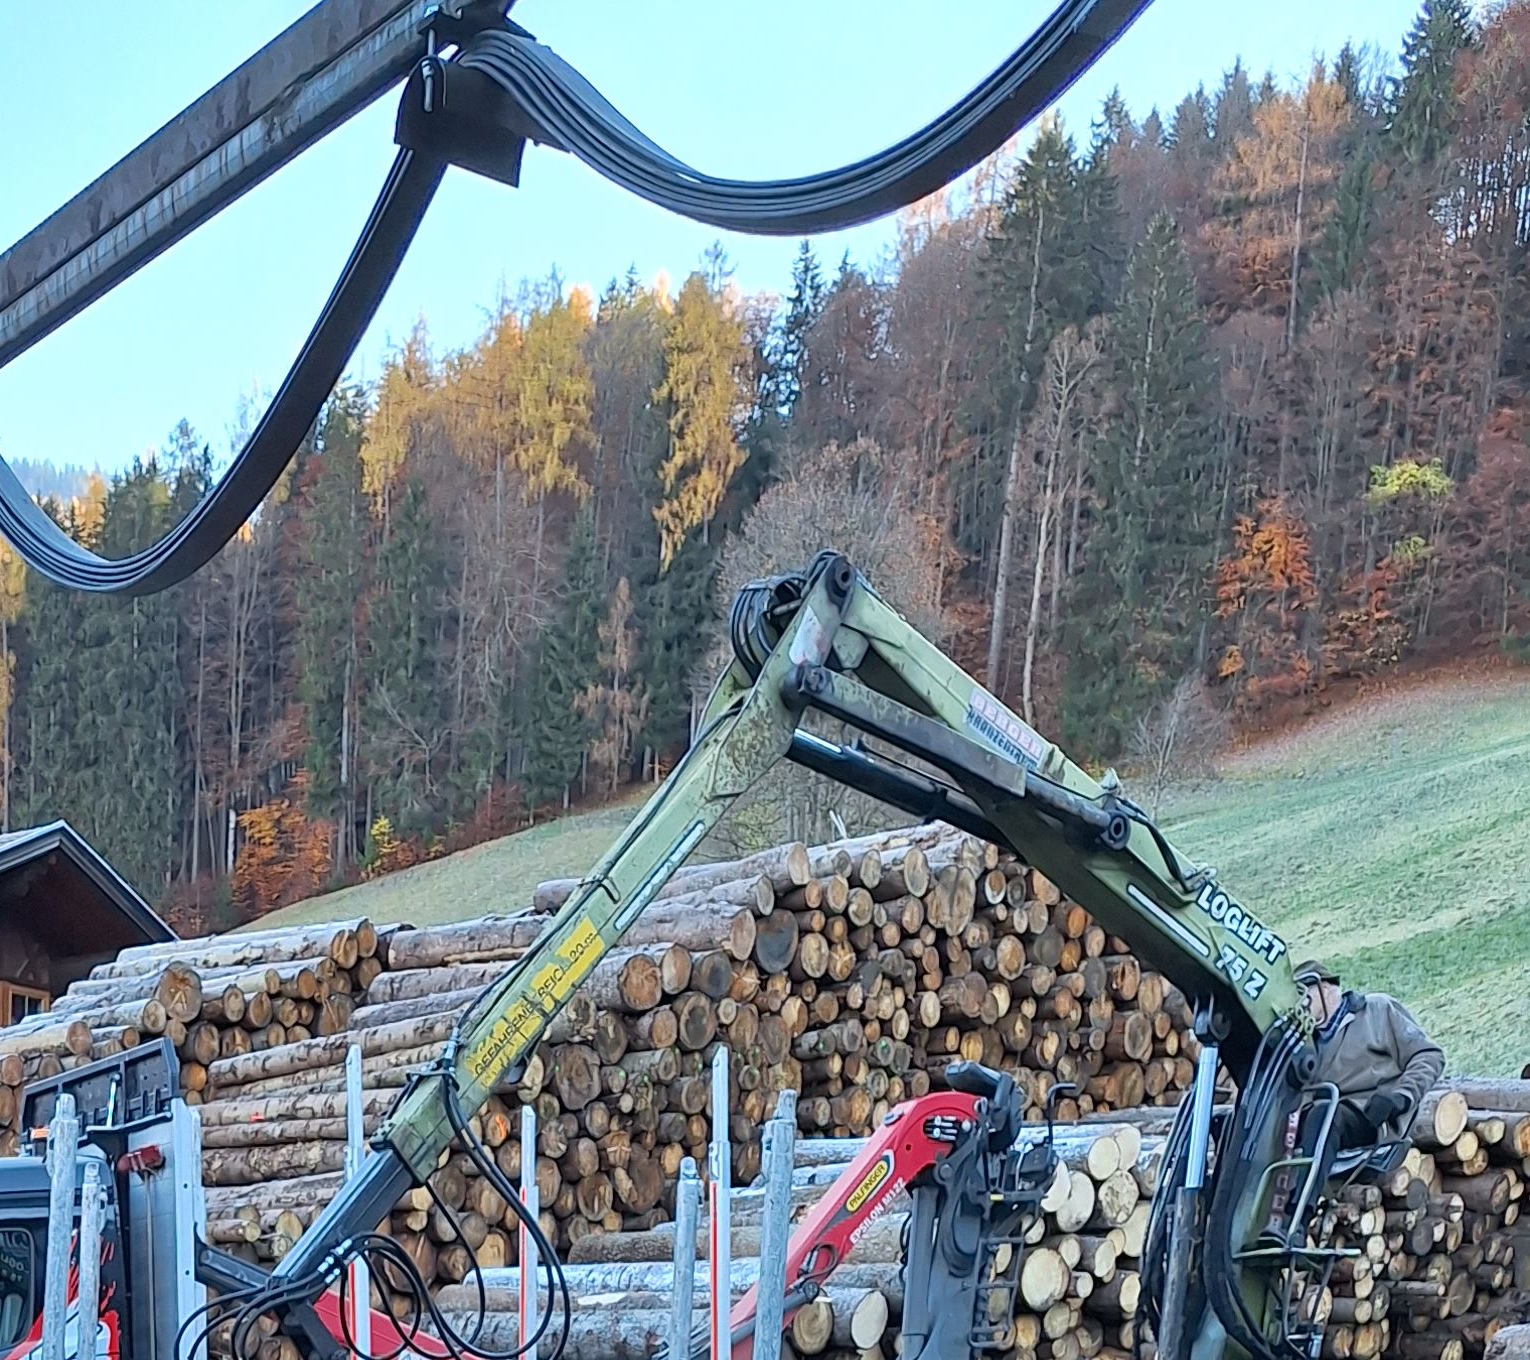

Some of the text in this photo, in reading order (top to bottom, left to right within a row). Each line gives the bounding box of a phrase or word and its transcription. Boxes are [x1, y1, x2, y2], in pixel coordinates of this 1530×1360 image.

[1197, 883, 1286, 965] LOGLIFT
[1214, 943, 1268, 1001] 75 Z
[849, 1163, 886, 1208] PALFINGER
[850, 1202, 885, 1244] EPSILON
